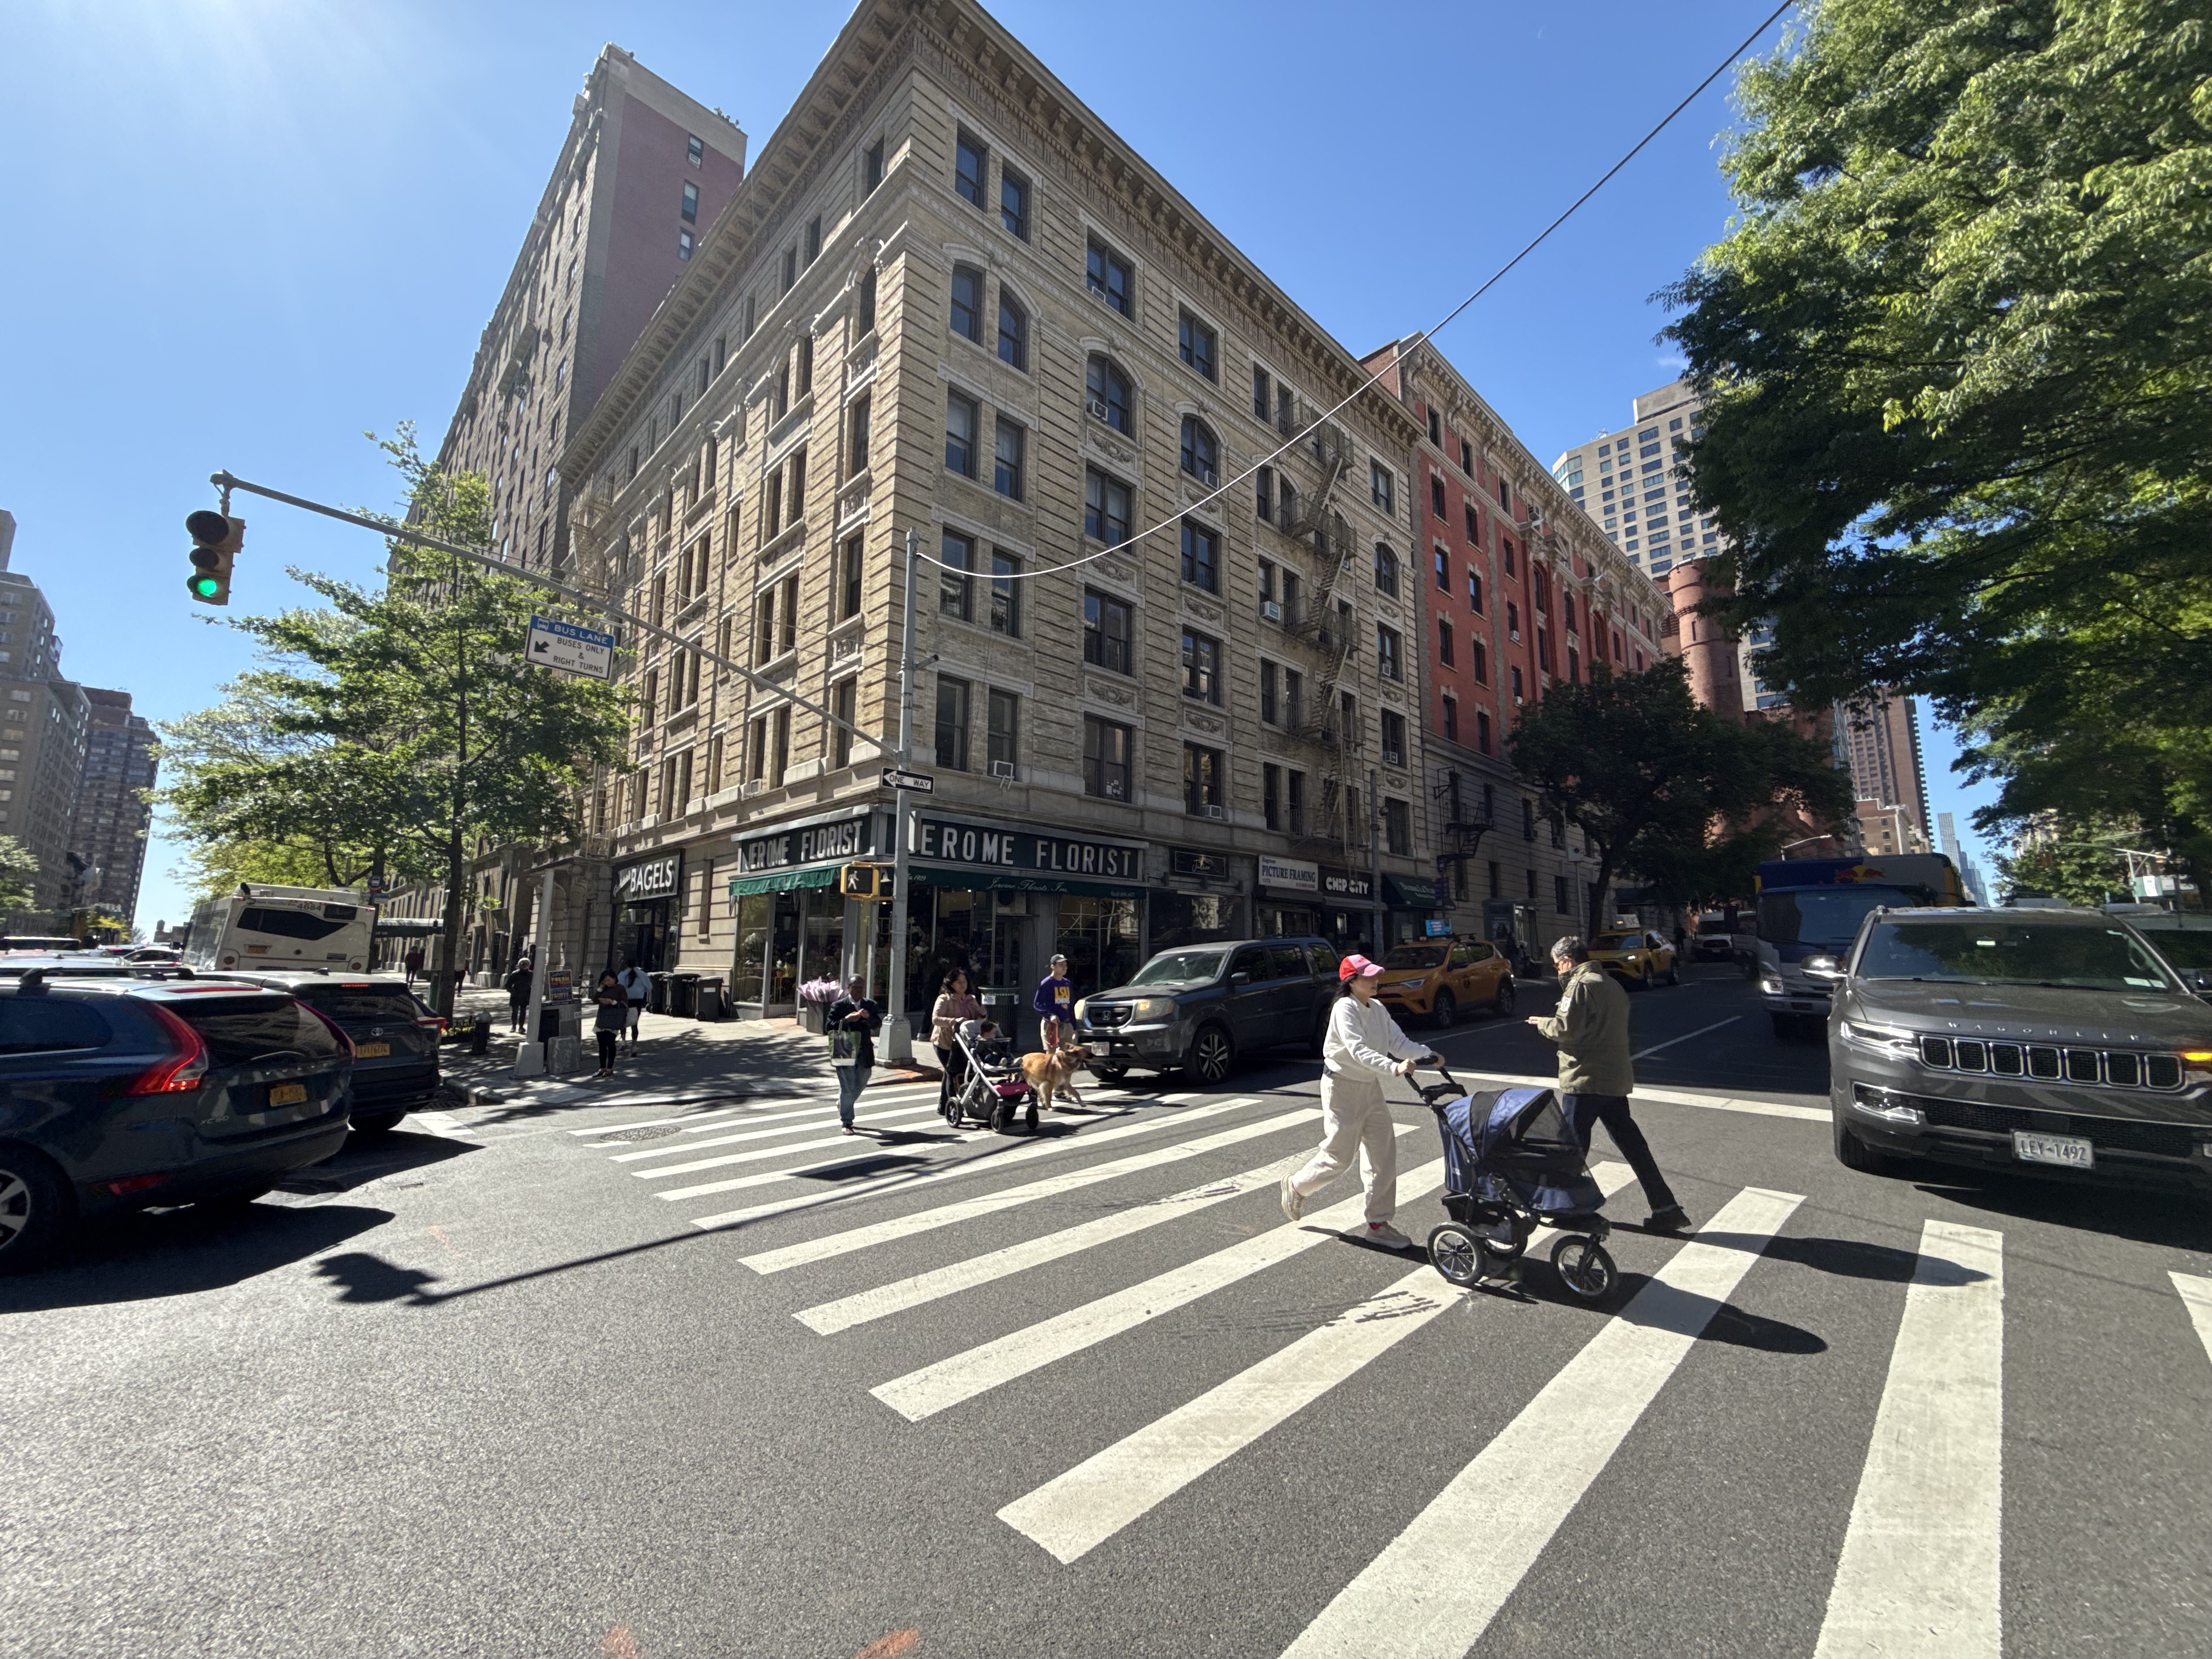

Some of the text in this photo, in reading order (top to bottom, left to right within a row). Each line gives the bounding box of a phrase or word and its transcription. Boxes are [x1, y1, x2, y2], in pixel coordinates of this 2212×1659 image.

[554, 625, 608, 645] BUS LANE
[557, 637, 605, 654] BUSES ONLY
[553, 656, 603, 674] RIGHT TURNS
[889, 774, 930, 788] ONE WAY
[745, 821, 863, 870] JEROME FLORIST
[909, 824, 1131, 876] EROME FLORIST
[629, 860, 673, 893] BAGELS
[1261, 865, 1316, 882] PICTURE FRAMING
[986, 877, 1015, 890] Jerome
[1054, 986, 1070, 998] LSU
